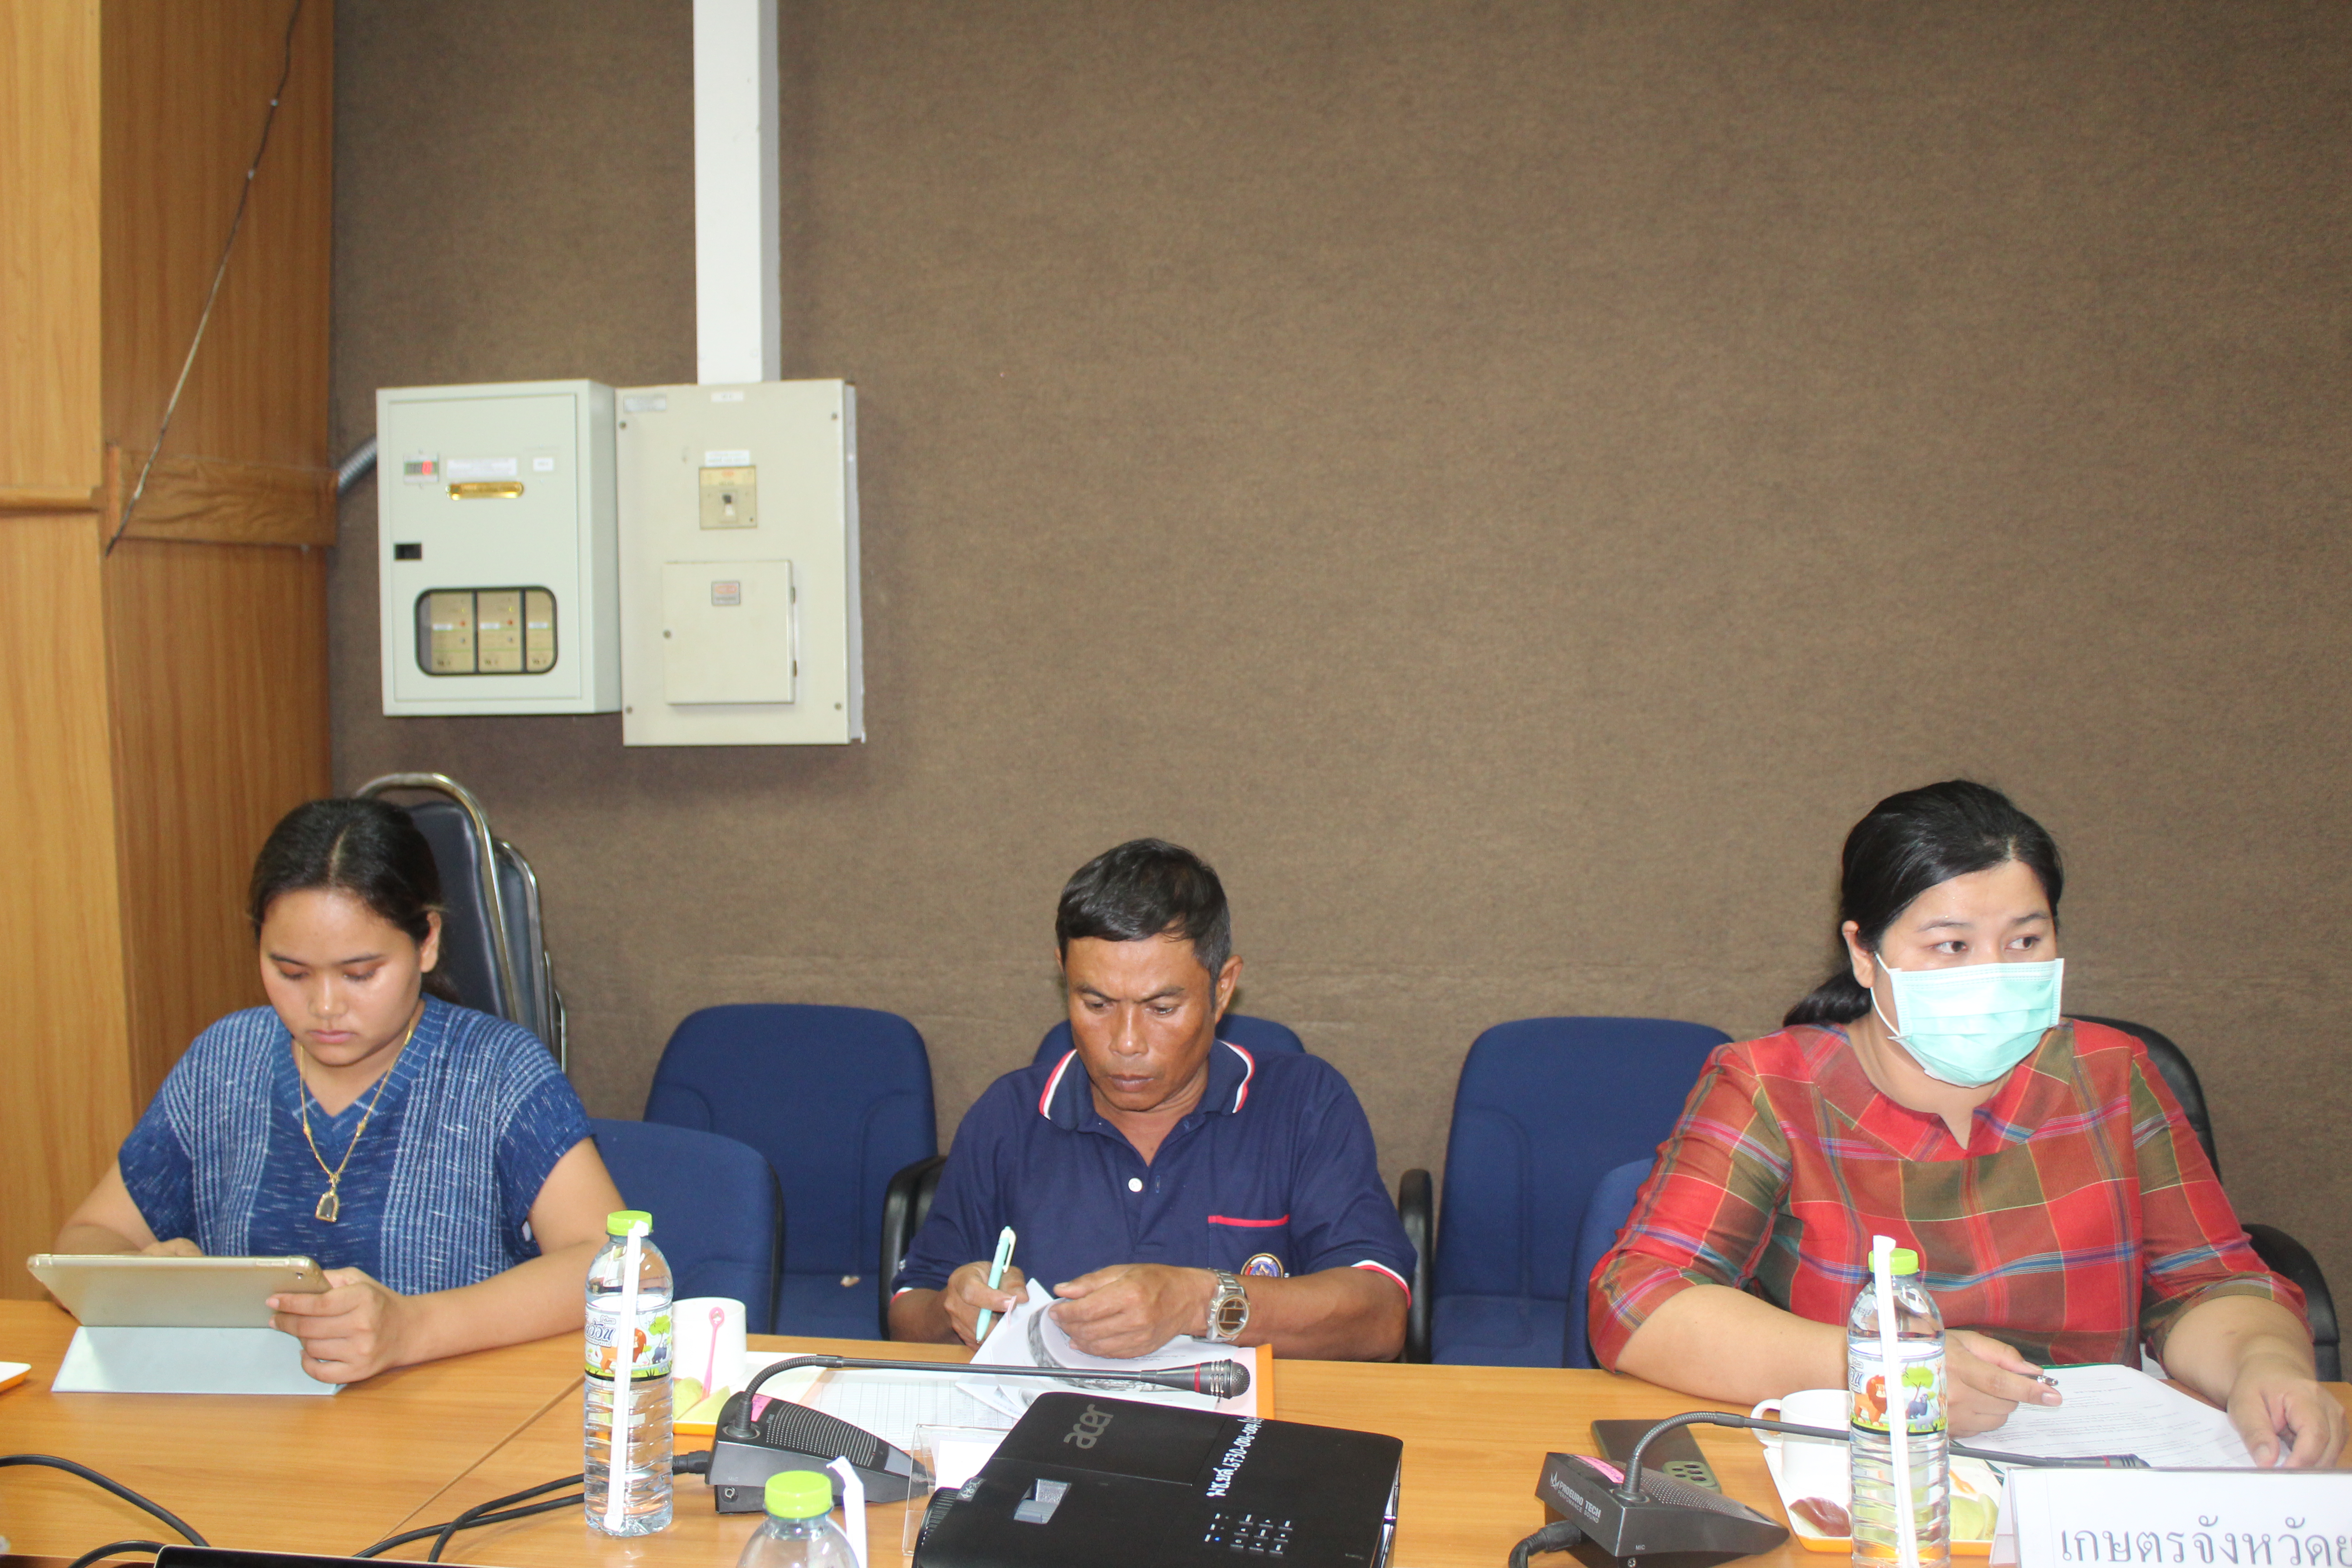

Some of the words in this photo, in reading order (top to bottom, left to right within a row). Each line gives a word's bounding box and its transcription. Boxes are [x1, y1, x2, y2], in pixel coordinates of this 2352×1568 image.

[1063, 1403, 1114, 1449] acer
[1558, 1480, 1584, 1506] PROEURO
[1585, 1500, 1602, 1518] TECH
[1583, 1509, 1600, 1524] SOUND
